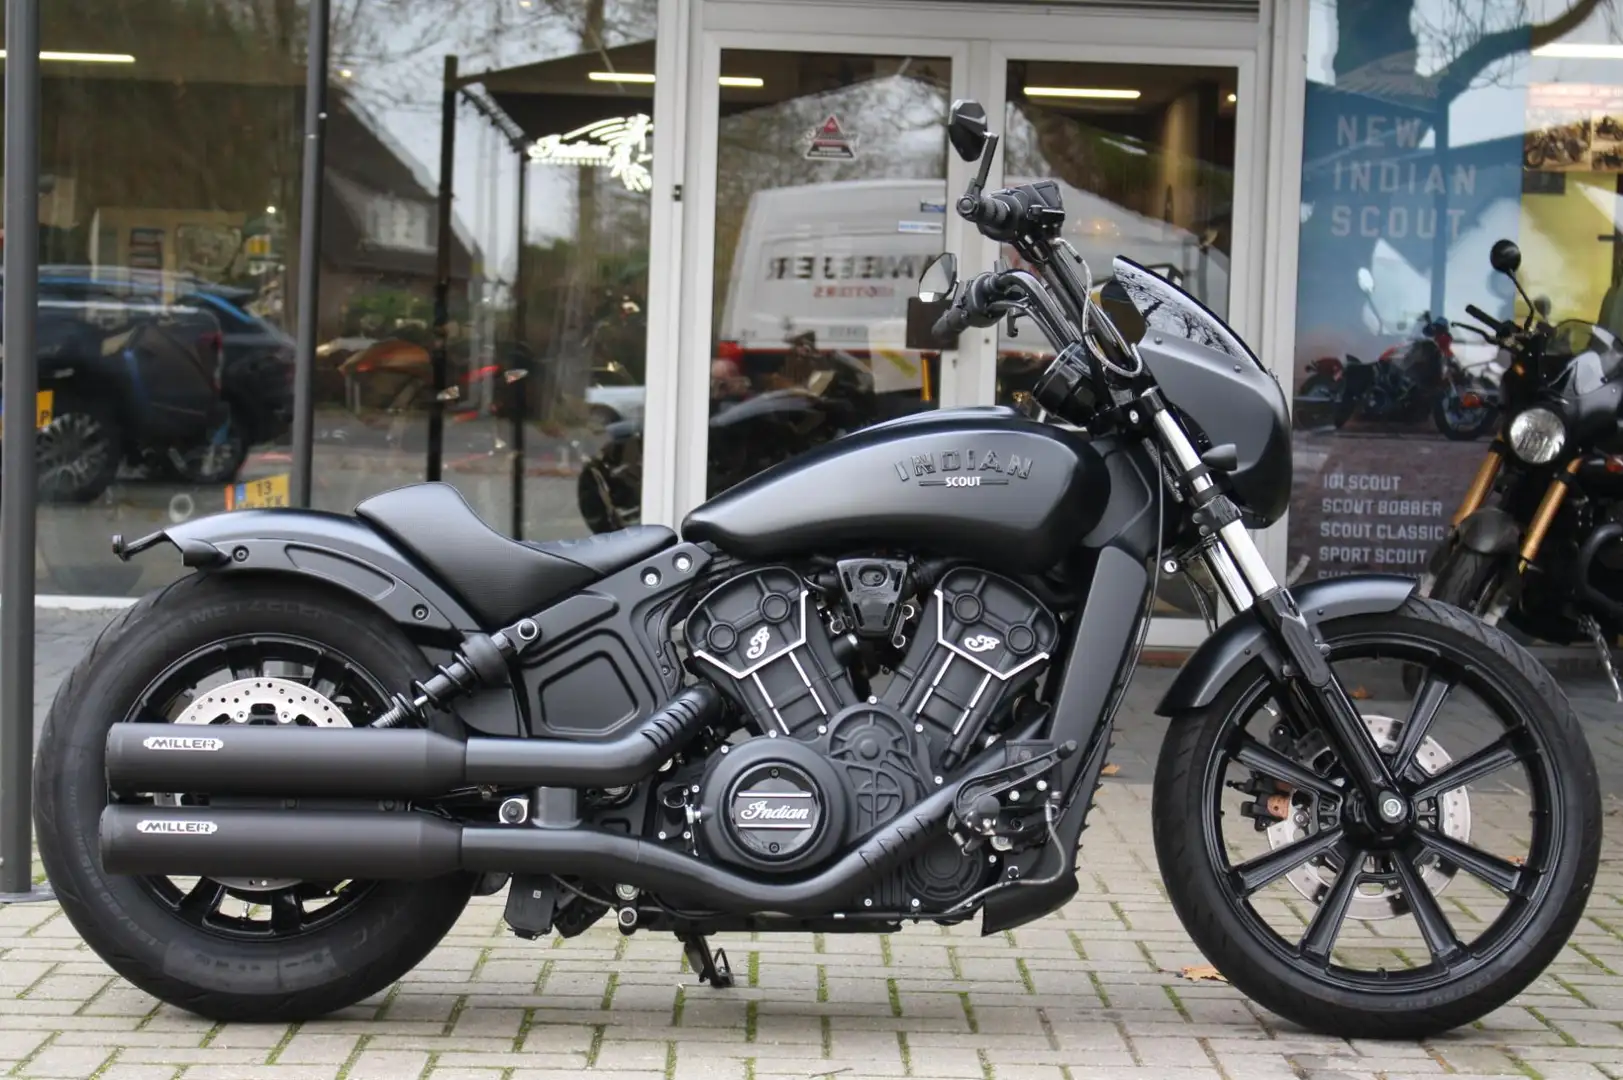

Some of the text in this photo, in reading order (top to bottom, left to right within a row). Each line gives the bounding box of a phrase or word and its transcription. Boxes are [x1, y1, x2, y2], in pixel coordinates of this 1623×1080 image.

[1337, 115, 1422, 148] NEW
[1333, 160, 1477, 195] INDIAN
[1331, 205, 1466, 241] SCOUT
[894, 449, 1034, 482] INDIAN
[945, 476, 982, 488] SCOUT
[1348, 474, 1402, 491] SCOUT
[1322, 498, 1443, 517] SCOUT BOBBER
[1320, 522, 1445, 540] SCOUT CLASSIC
[1319, 546, 1428, 564] SPORT SCOUT
[152, 738, 216, 750] MILLER
[740, 800, 809, 820] Indian
[144, 822, 210, 833] MILLER
